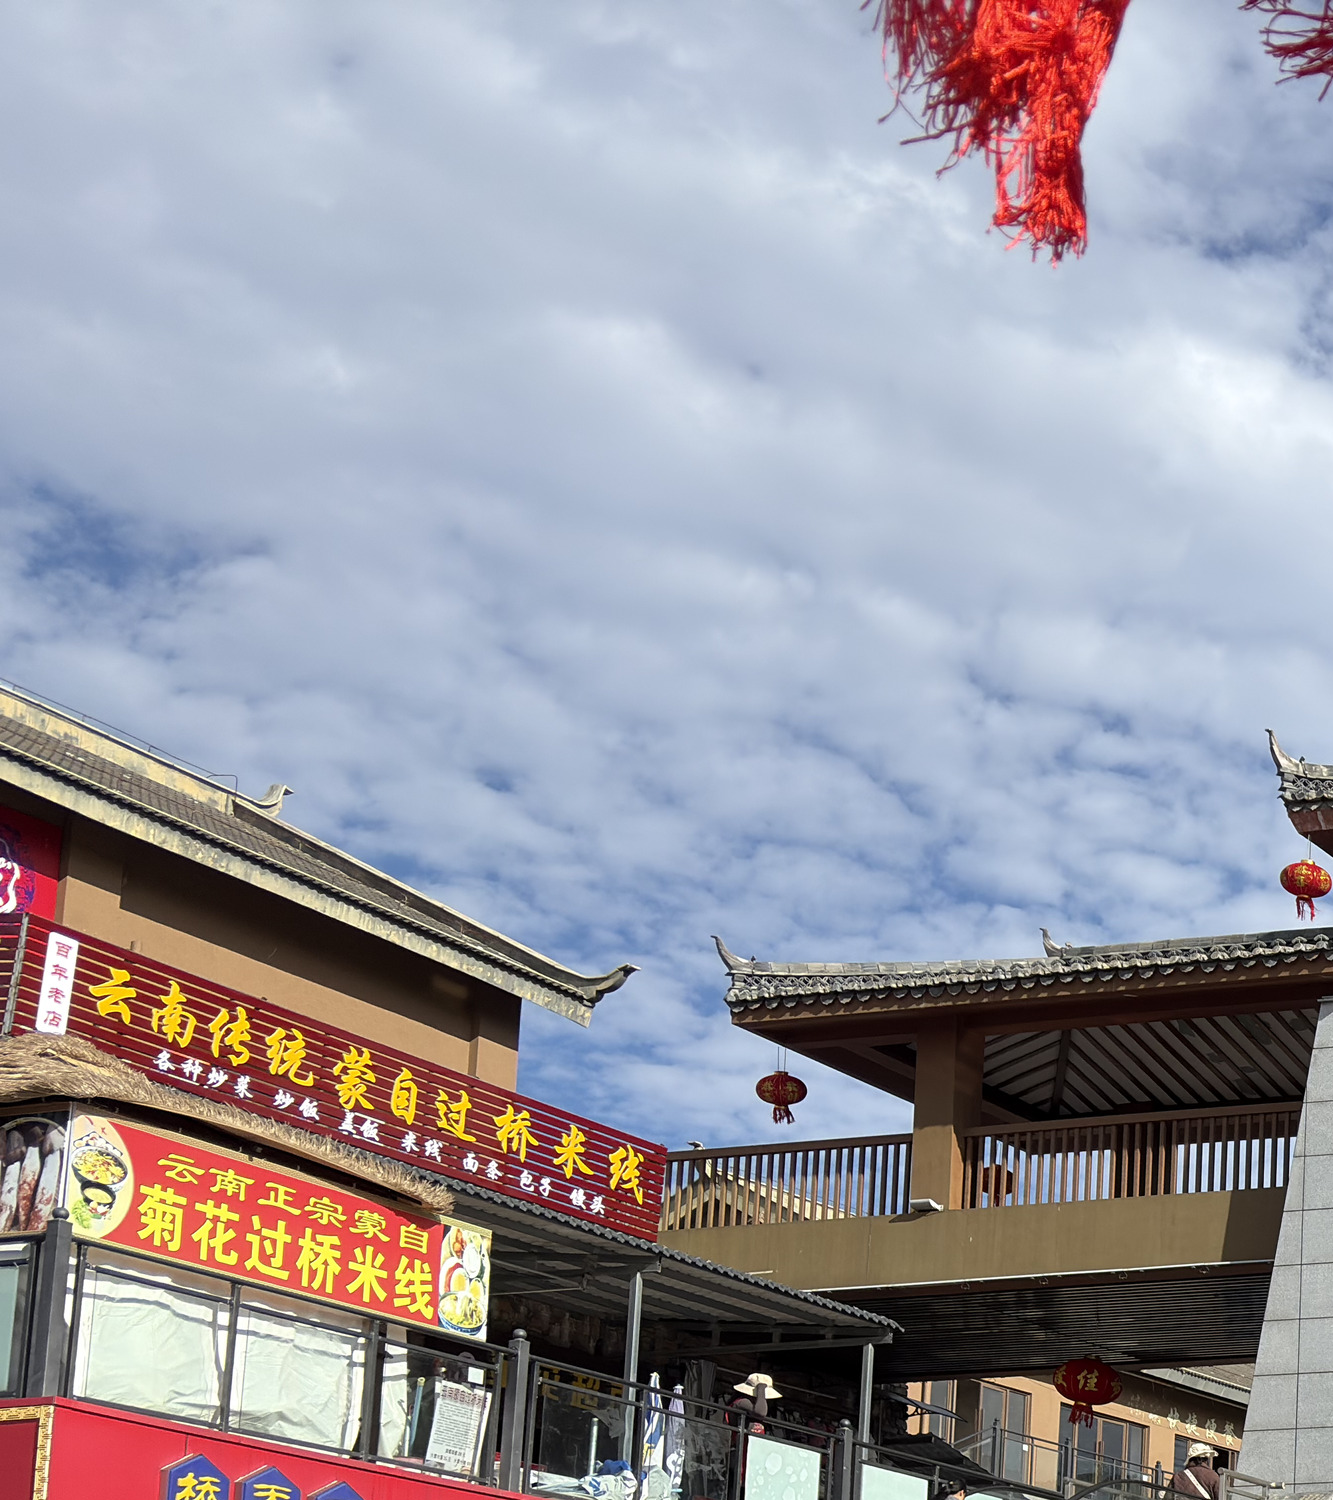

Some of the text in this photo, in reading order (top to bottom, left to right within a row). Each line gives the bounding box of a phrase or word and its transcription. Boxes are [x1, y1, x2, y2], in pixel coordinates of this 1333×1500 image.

[44, 940, 73, 1028] 百年老店
[153, 1050, 606, 1215] 各种炒菜 炒饭 盖饭 米线 面条 包子 馒头
[137, 1183, 435, 1320] 菊花过桥米线
[157, 1153, 430, 1254] 云南正宗蒙自
